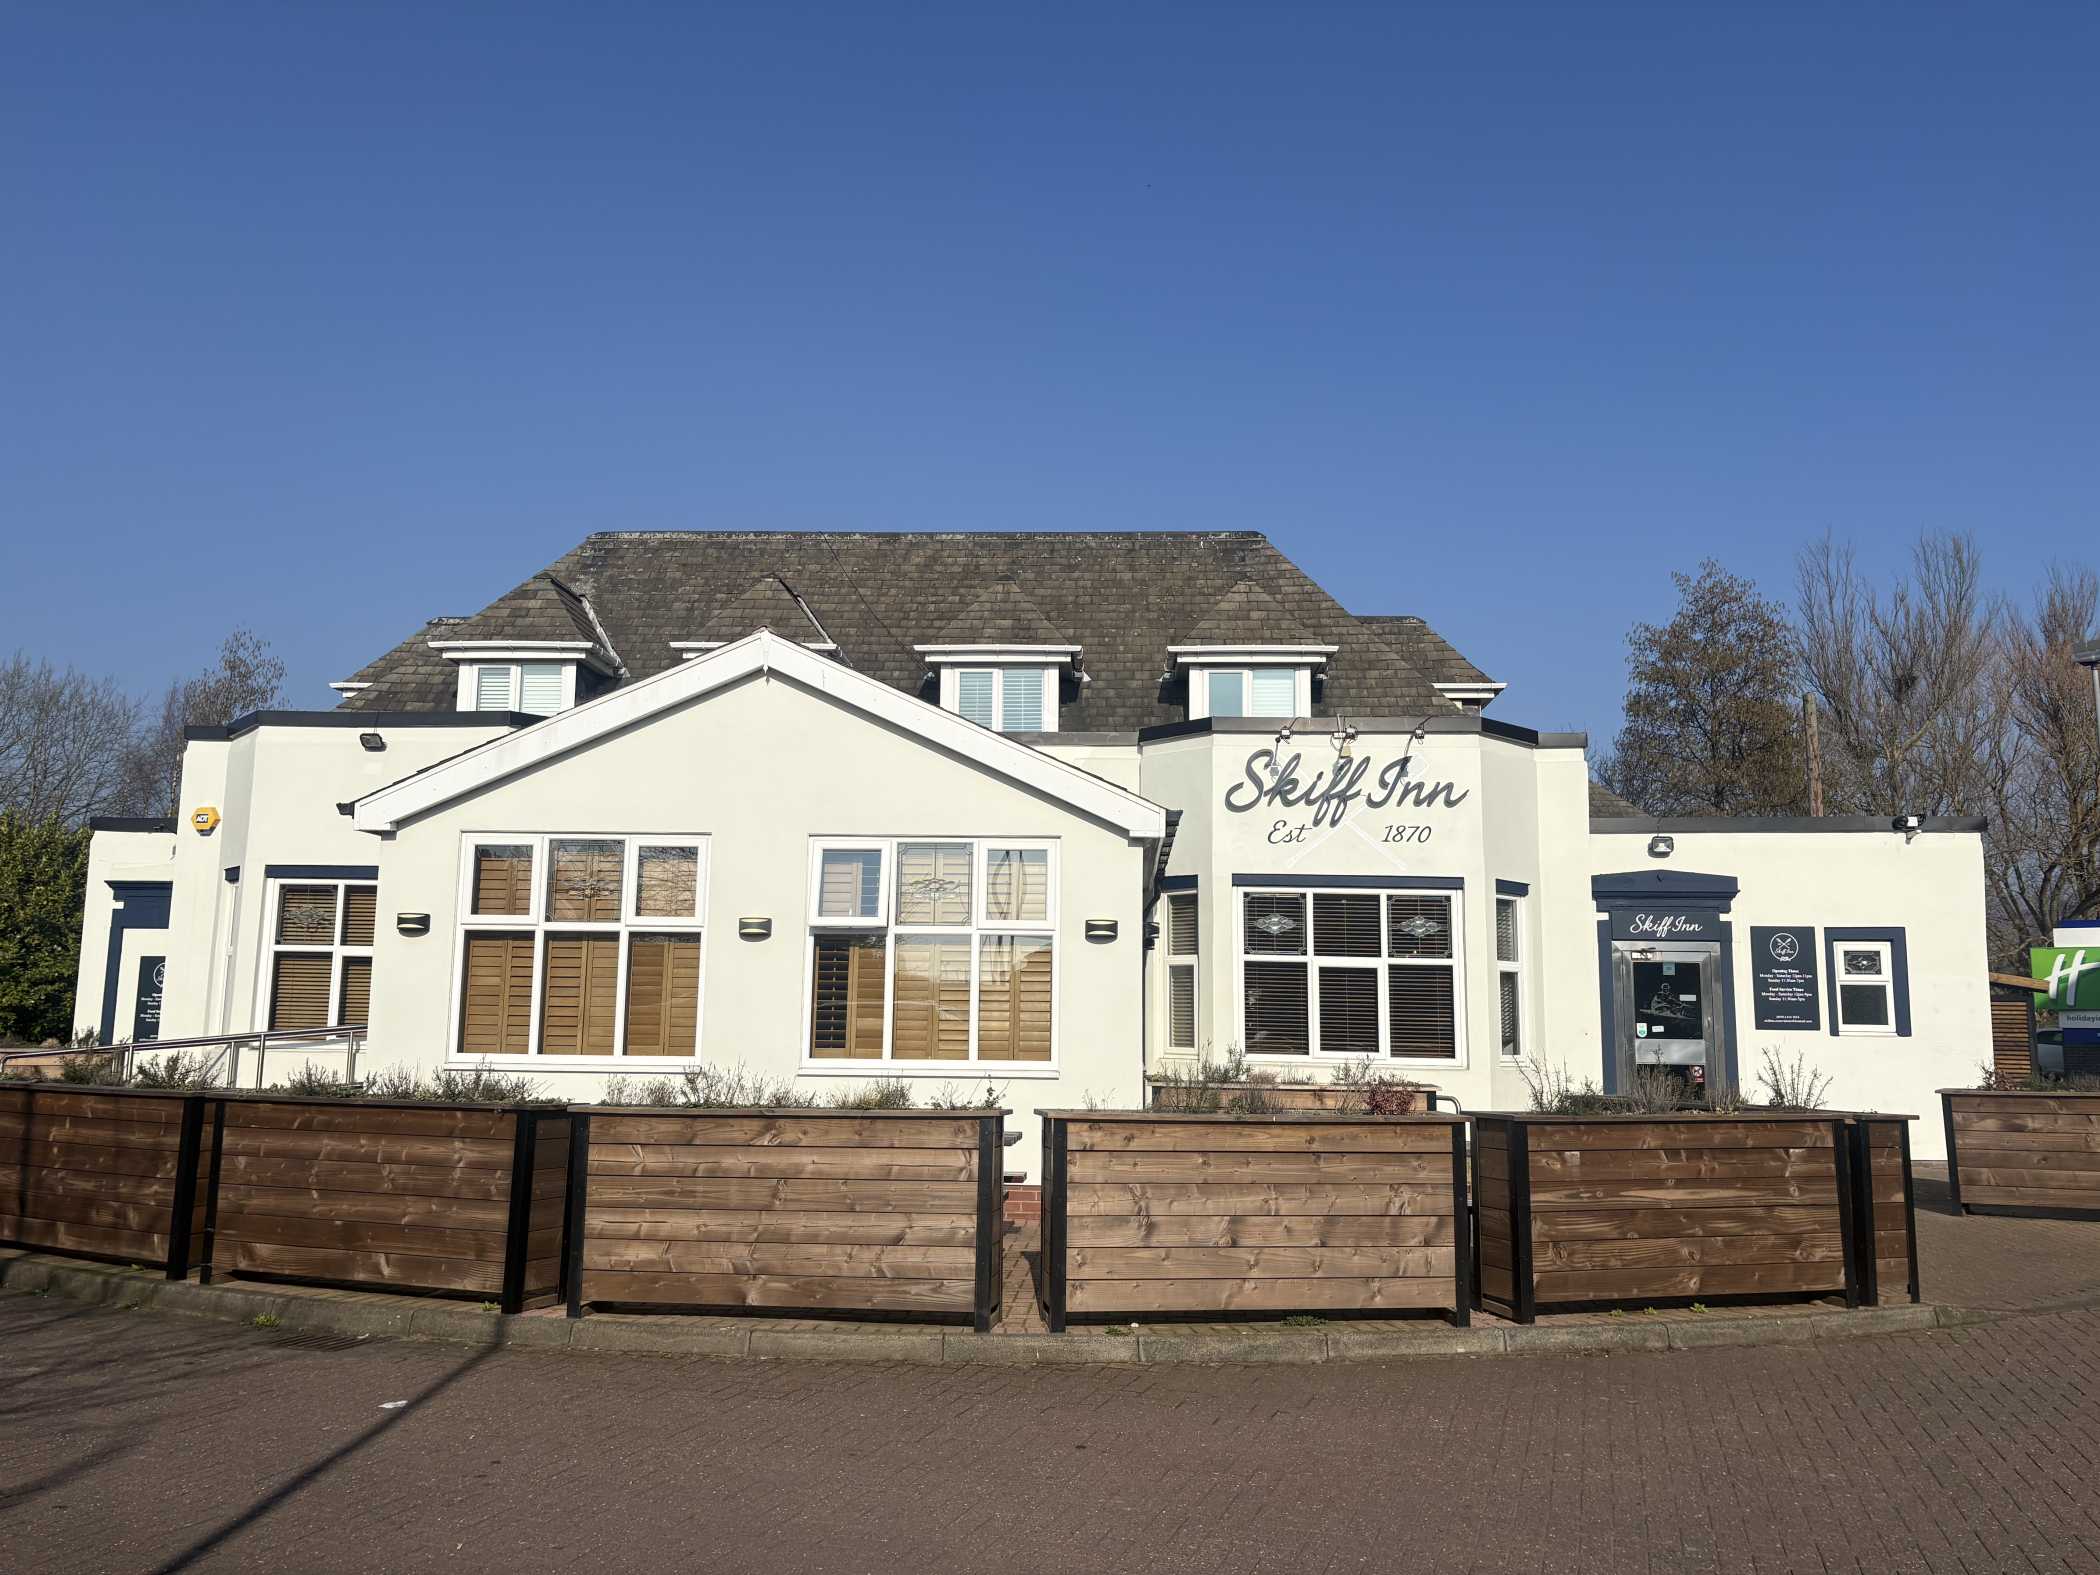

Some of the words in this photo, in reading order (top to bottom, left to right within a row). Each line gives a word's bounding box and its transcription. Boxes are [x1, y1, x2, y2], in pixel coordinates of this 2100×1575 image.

[1224, 748, 1371, 828] Skiff
[1365, 755, 1470, 809] Inn
[1267, 819, 1313, 844] Est
[1381, 824, 1432, 843] 1870
[1630, 913, 1673, 937] Skiff
[1671, 915, 1703, 932] Inn
